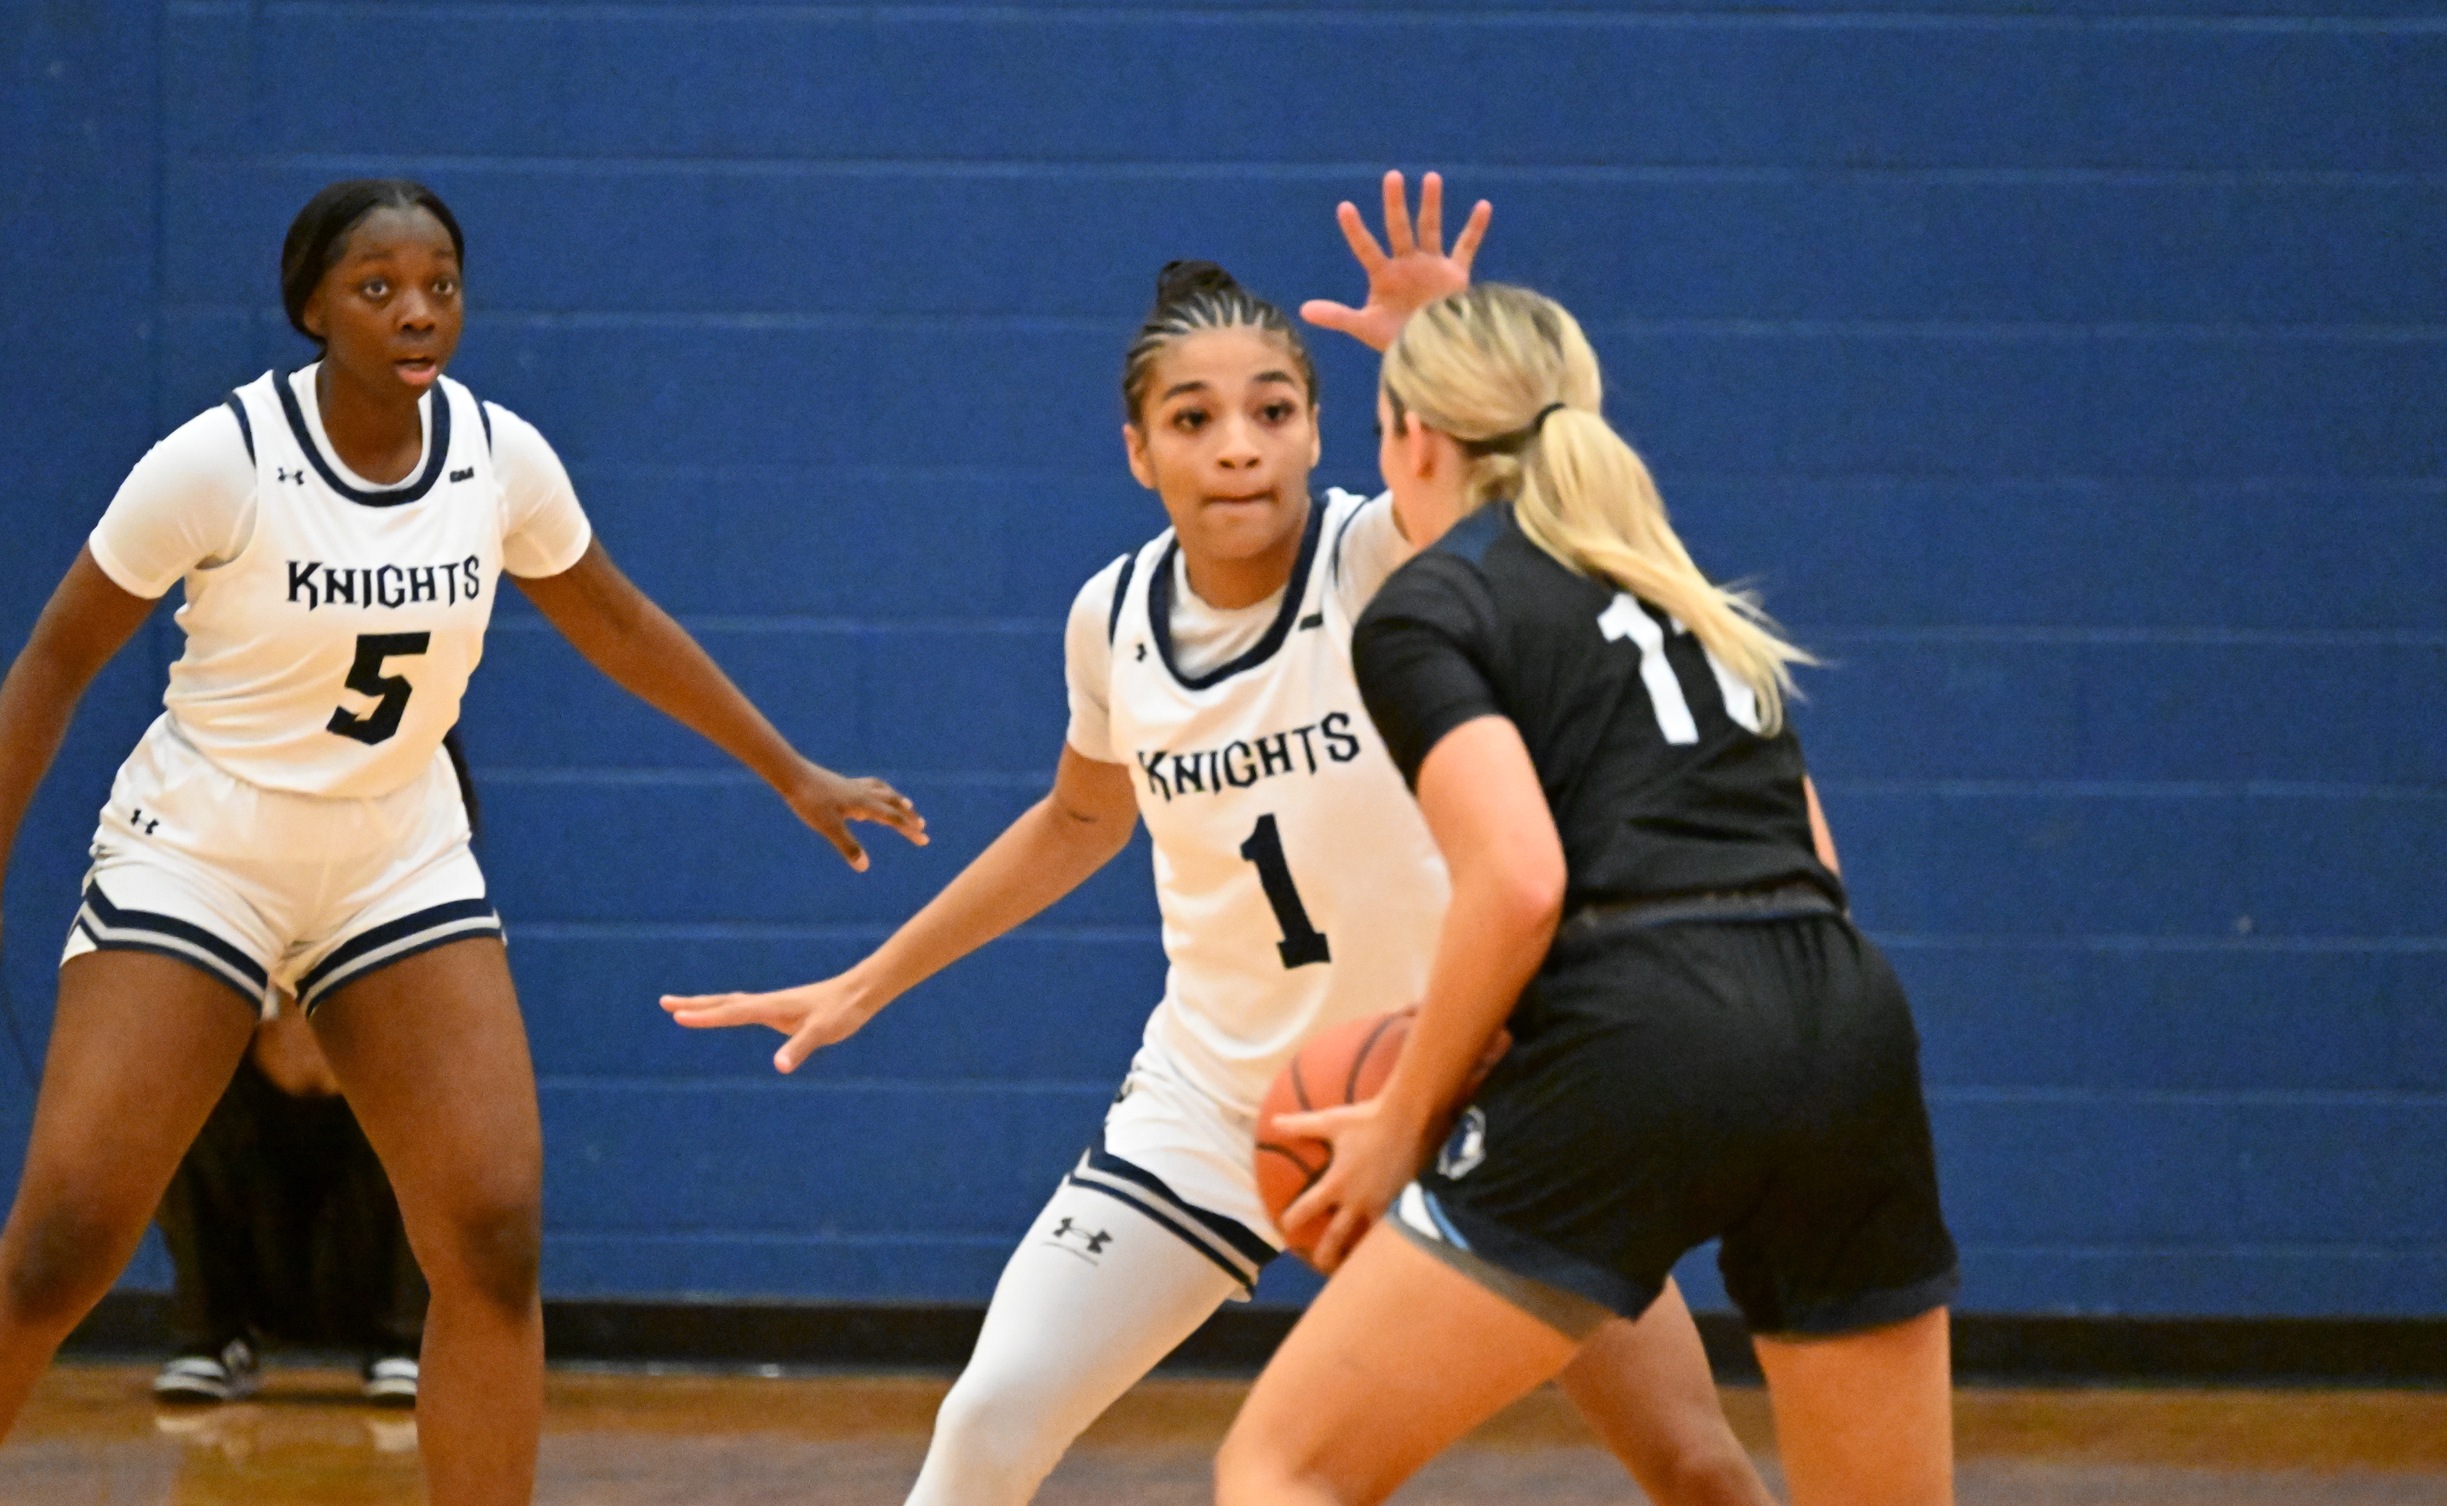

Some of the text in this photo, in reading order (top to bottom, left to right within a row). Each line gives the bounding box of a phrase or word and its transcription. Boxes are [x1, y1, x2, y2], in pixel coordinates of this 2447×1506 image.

[286, 555, 480, 611] KNIGHTS
[326, 631, 431, 745] 5
[1138, 712, 1361, 801] KNIGHTS
[1240, 813, 1331, 970] 1
